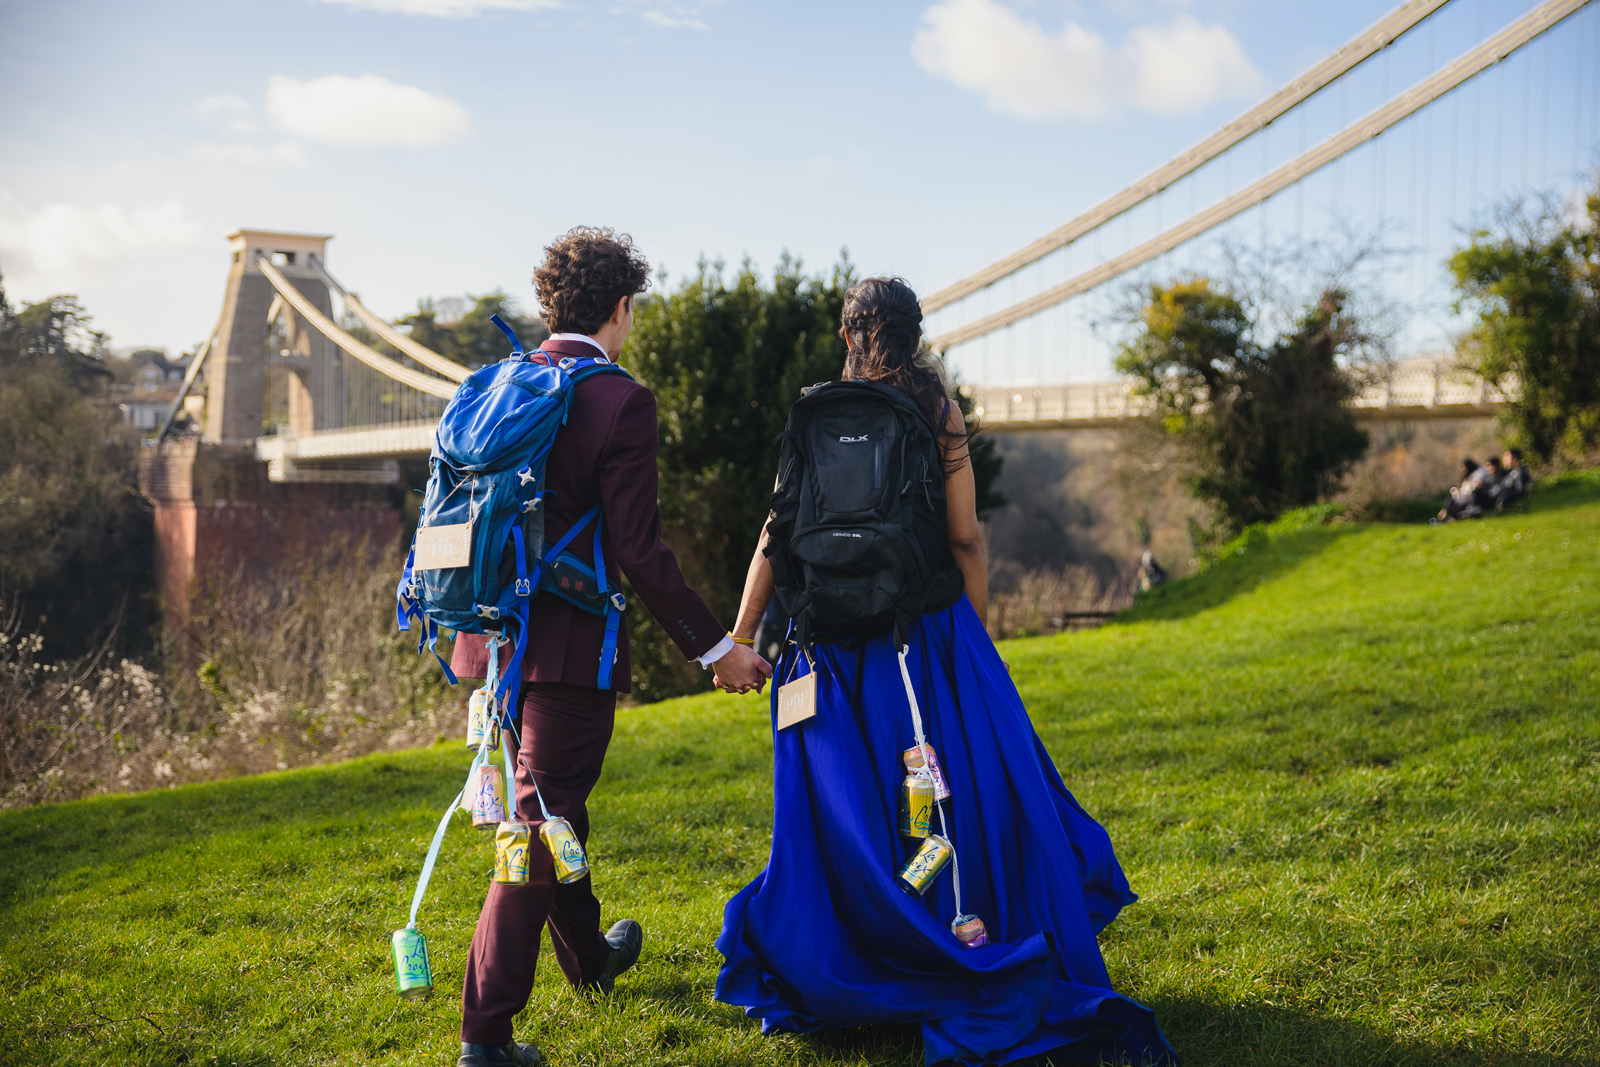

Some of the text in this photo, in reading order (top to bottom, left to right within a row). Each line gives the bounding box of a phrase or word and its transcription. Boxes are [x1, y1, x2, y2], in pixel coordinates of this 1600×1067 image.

[839, 434, 869, 443] DLX
[480, 775, 495, 796] La
[920, 846, 939, 864] La
[411, 938, 425, 958] La
